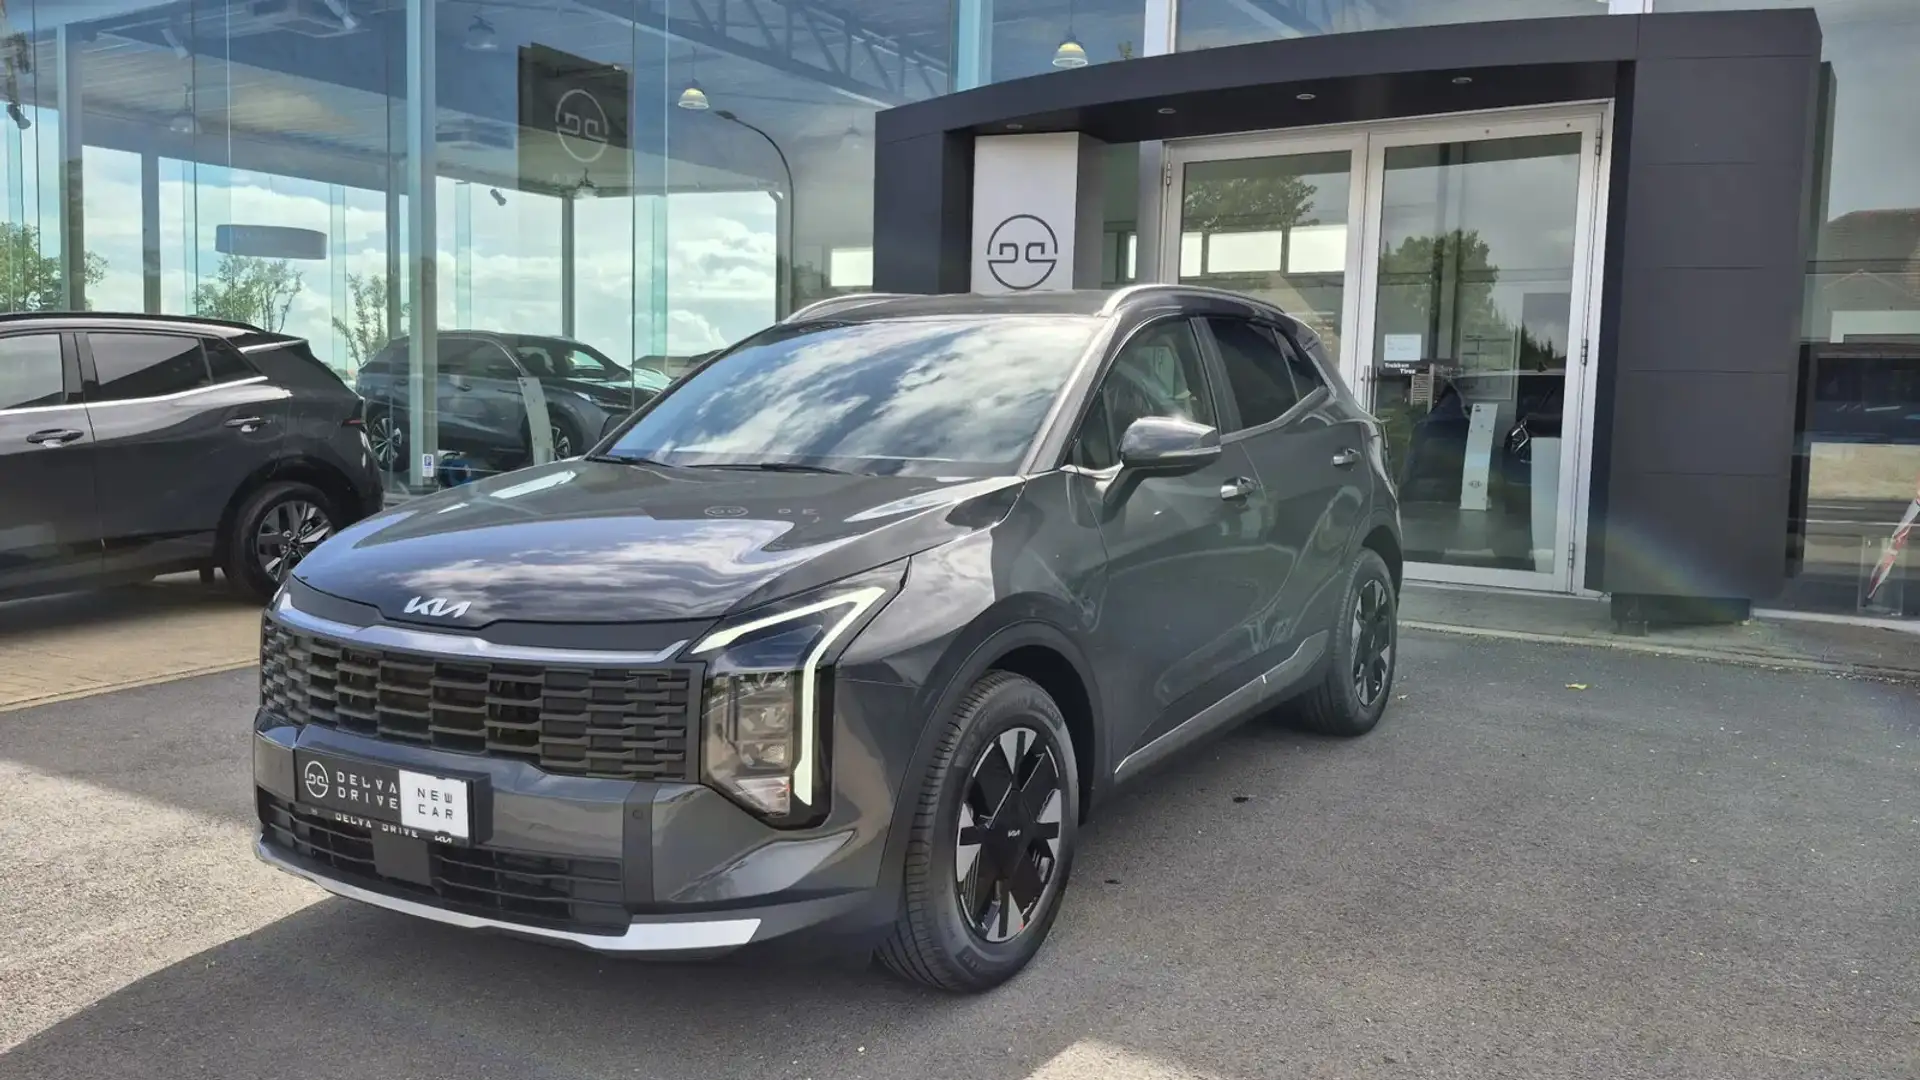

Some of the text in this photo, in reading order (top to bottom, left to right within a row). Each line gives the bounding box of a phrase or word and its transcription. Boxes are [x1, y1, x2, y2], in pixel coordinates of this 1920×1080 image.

[404, 596, 472, 618] KIA
[336, 771, 398, 793] DELVA
[337, 786, 399, 810] DRIVE
[418, 787, 453, 803] NEW
[418, 804, 453, 820] CAR
[335, 813, 418, 838] DELVA DRIVE
